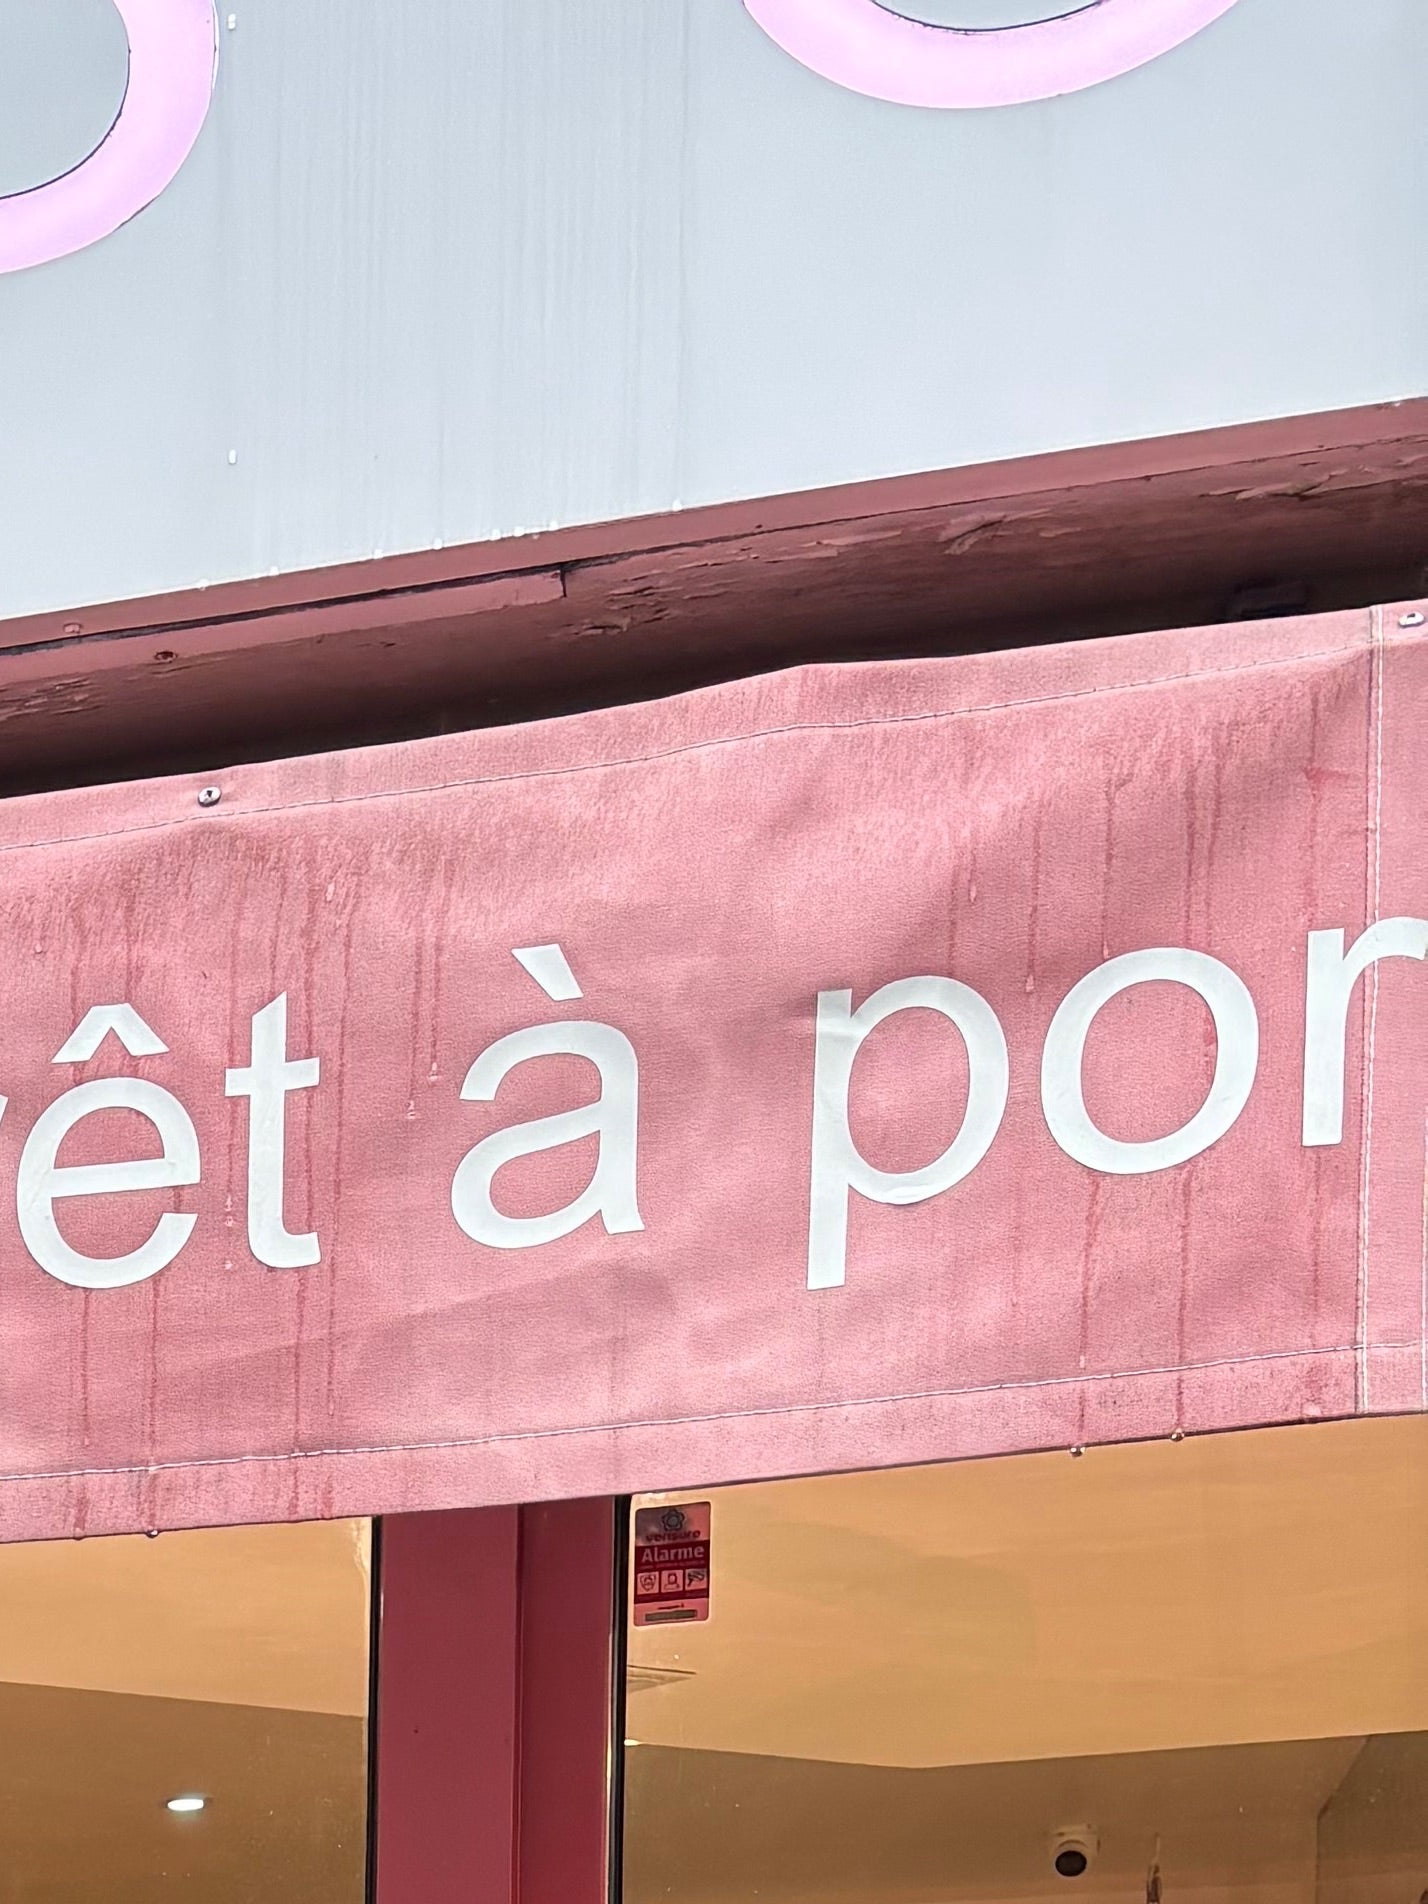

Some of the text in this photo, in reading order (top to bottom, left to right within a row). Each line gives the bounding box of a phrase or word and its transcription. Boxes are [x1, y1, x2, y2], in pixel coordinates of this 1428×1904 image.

[450, 943, 646, 1249] à
[807, 916, 1428, 1291] por
[641, 1546, 705, 1563] Alarme
